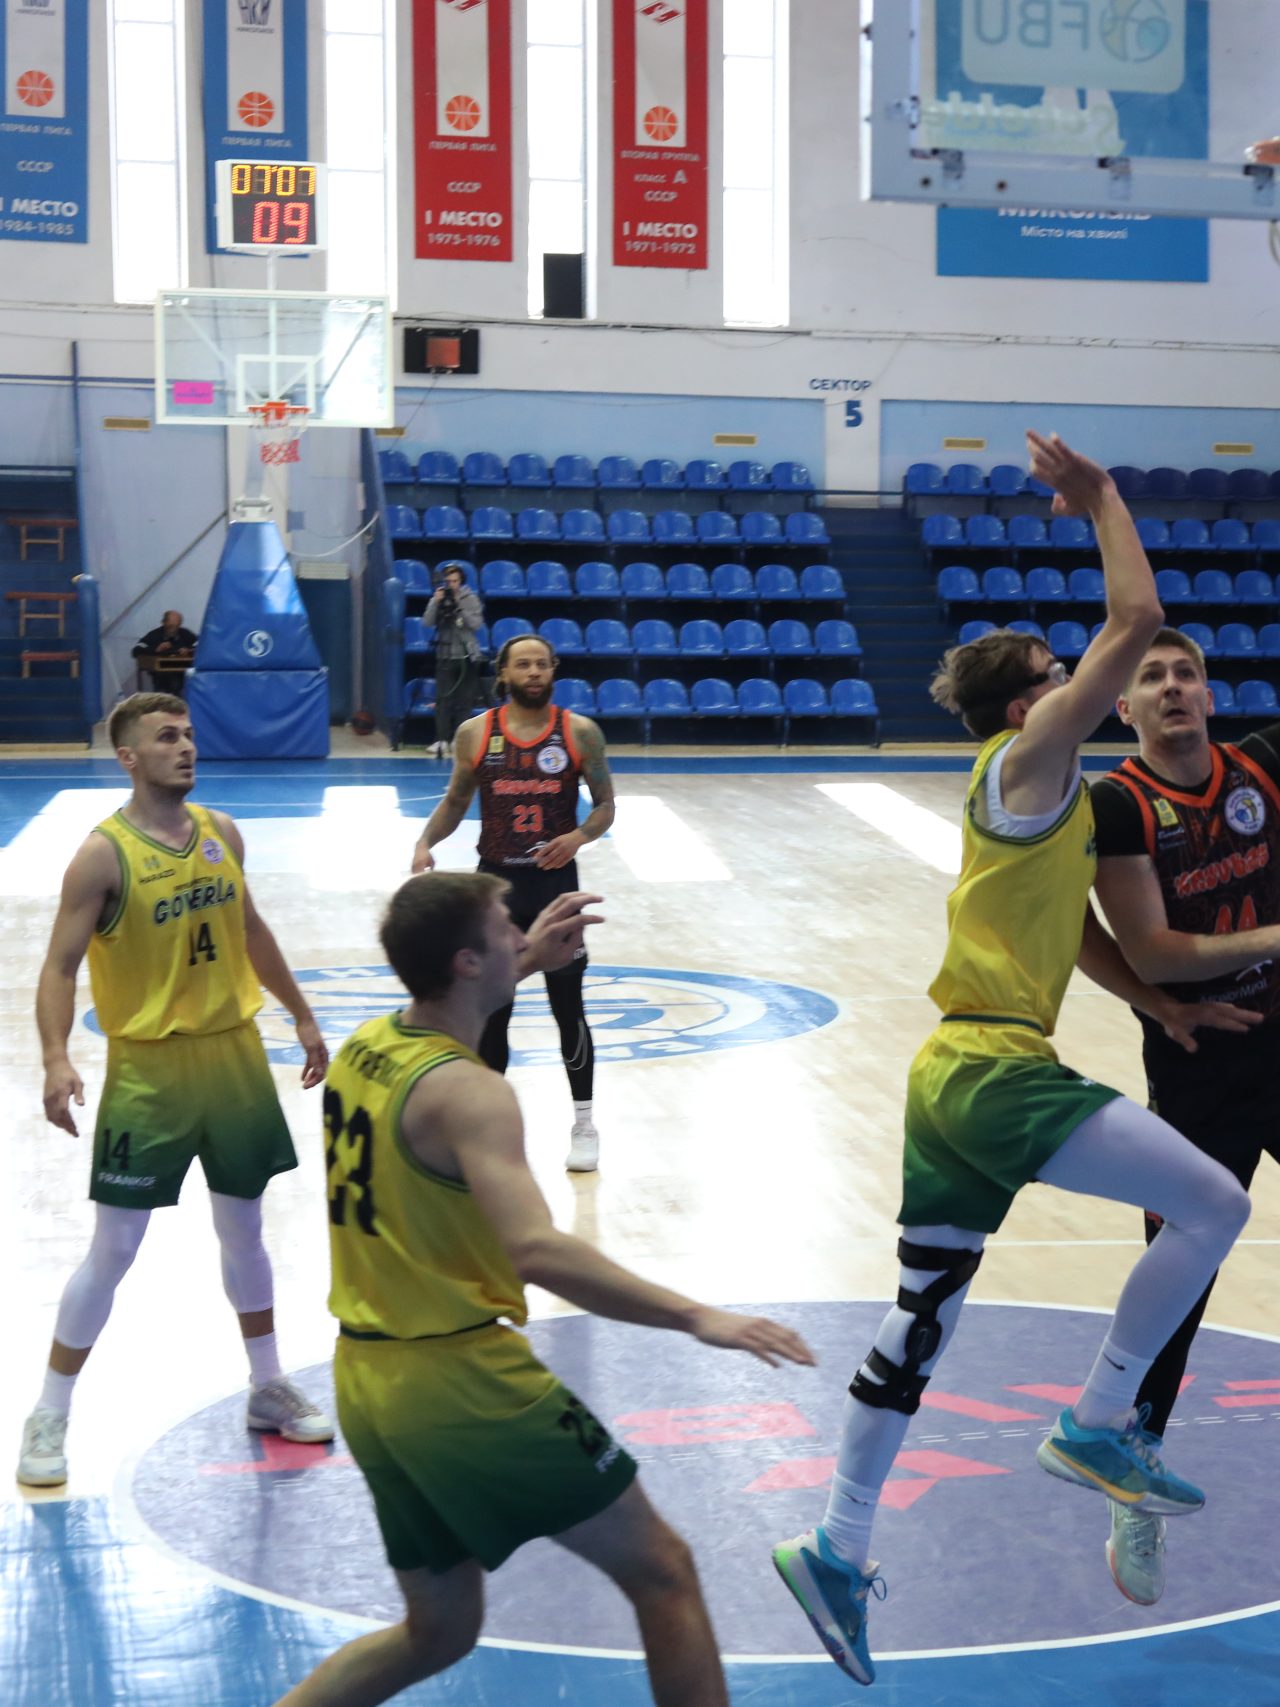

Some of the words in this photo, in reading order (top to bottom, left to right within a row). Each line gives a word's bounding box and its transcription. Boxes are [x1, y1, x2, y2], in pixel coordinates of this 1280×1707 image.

[16, 160, 55, 174] СССР
[672, 168, 689, 185] А
[446, 180, 482, 194] СССР
[643, 189, 679, 203] СССР
[10, 198, 80, 218] МЕСТО
[251, 200, 310, 245] 09
[438, 210, 504, 228] МЕСТО
[635, 221, 700, 239] МЕСТО
[1019, 225, 1064, 239] Місто
[427, 232, 502, 247] 1975-1976
[624, 239, 697, 255] 1971-1972
[808, 378, 872, 392] СЕКТОР
[845, 400, 864, 428] 5
[513, 804, 543, 833] 23
[154, 875, 236, 927] GOVERLA
[188, 921, 218, 967] 14
[101, 1127, 131, 1172] 14
